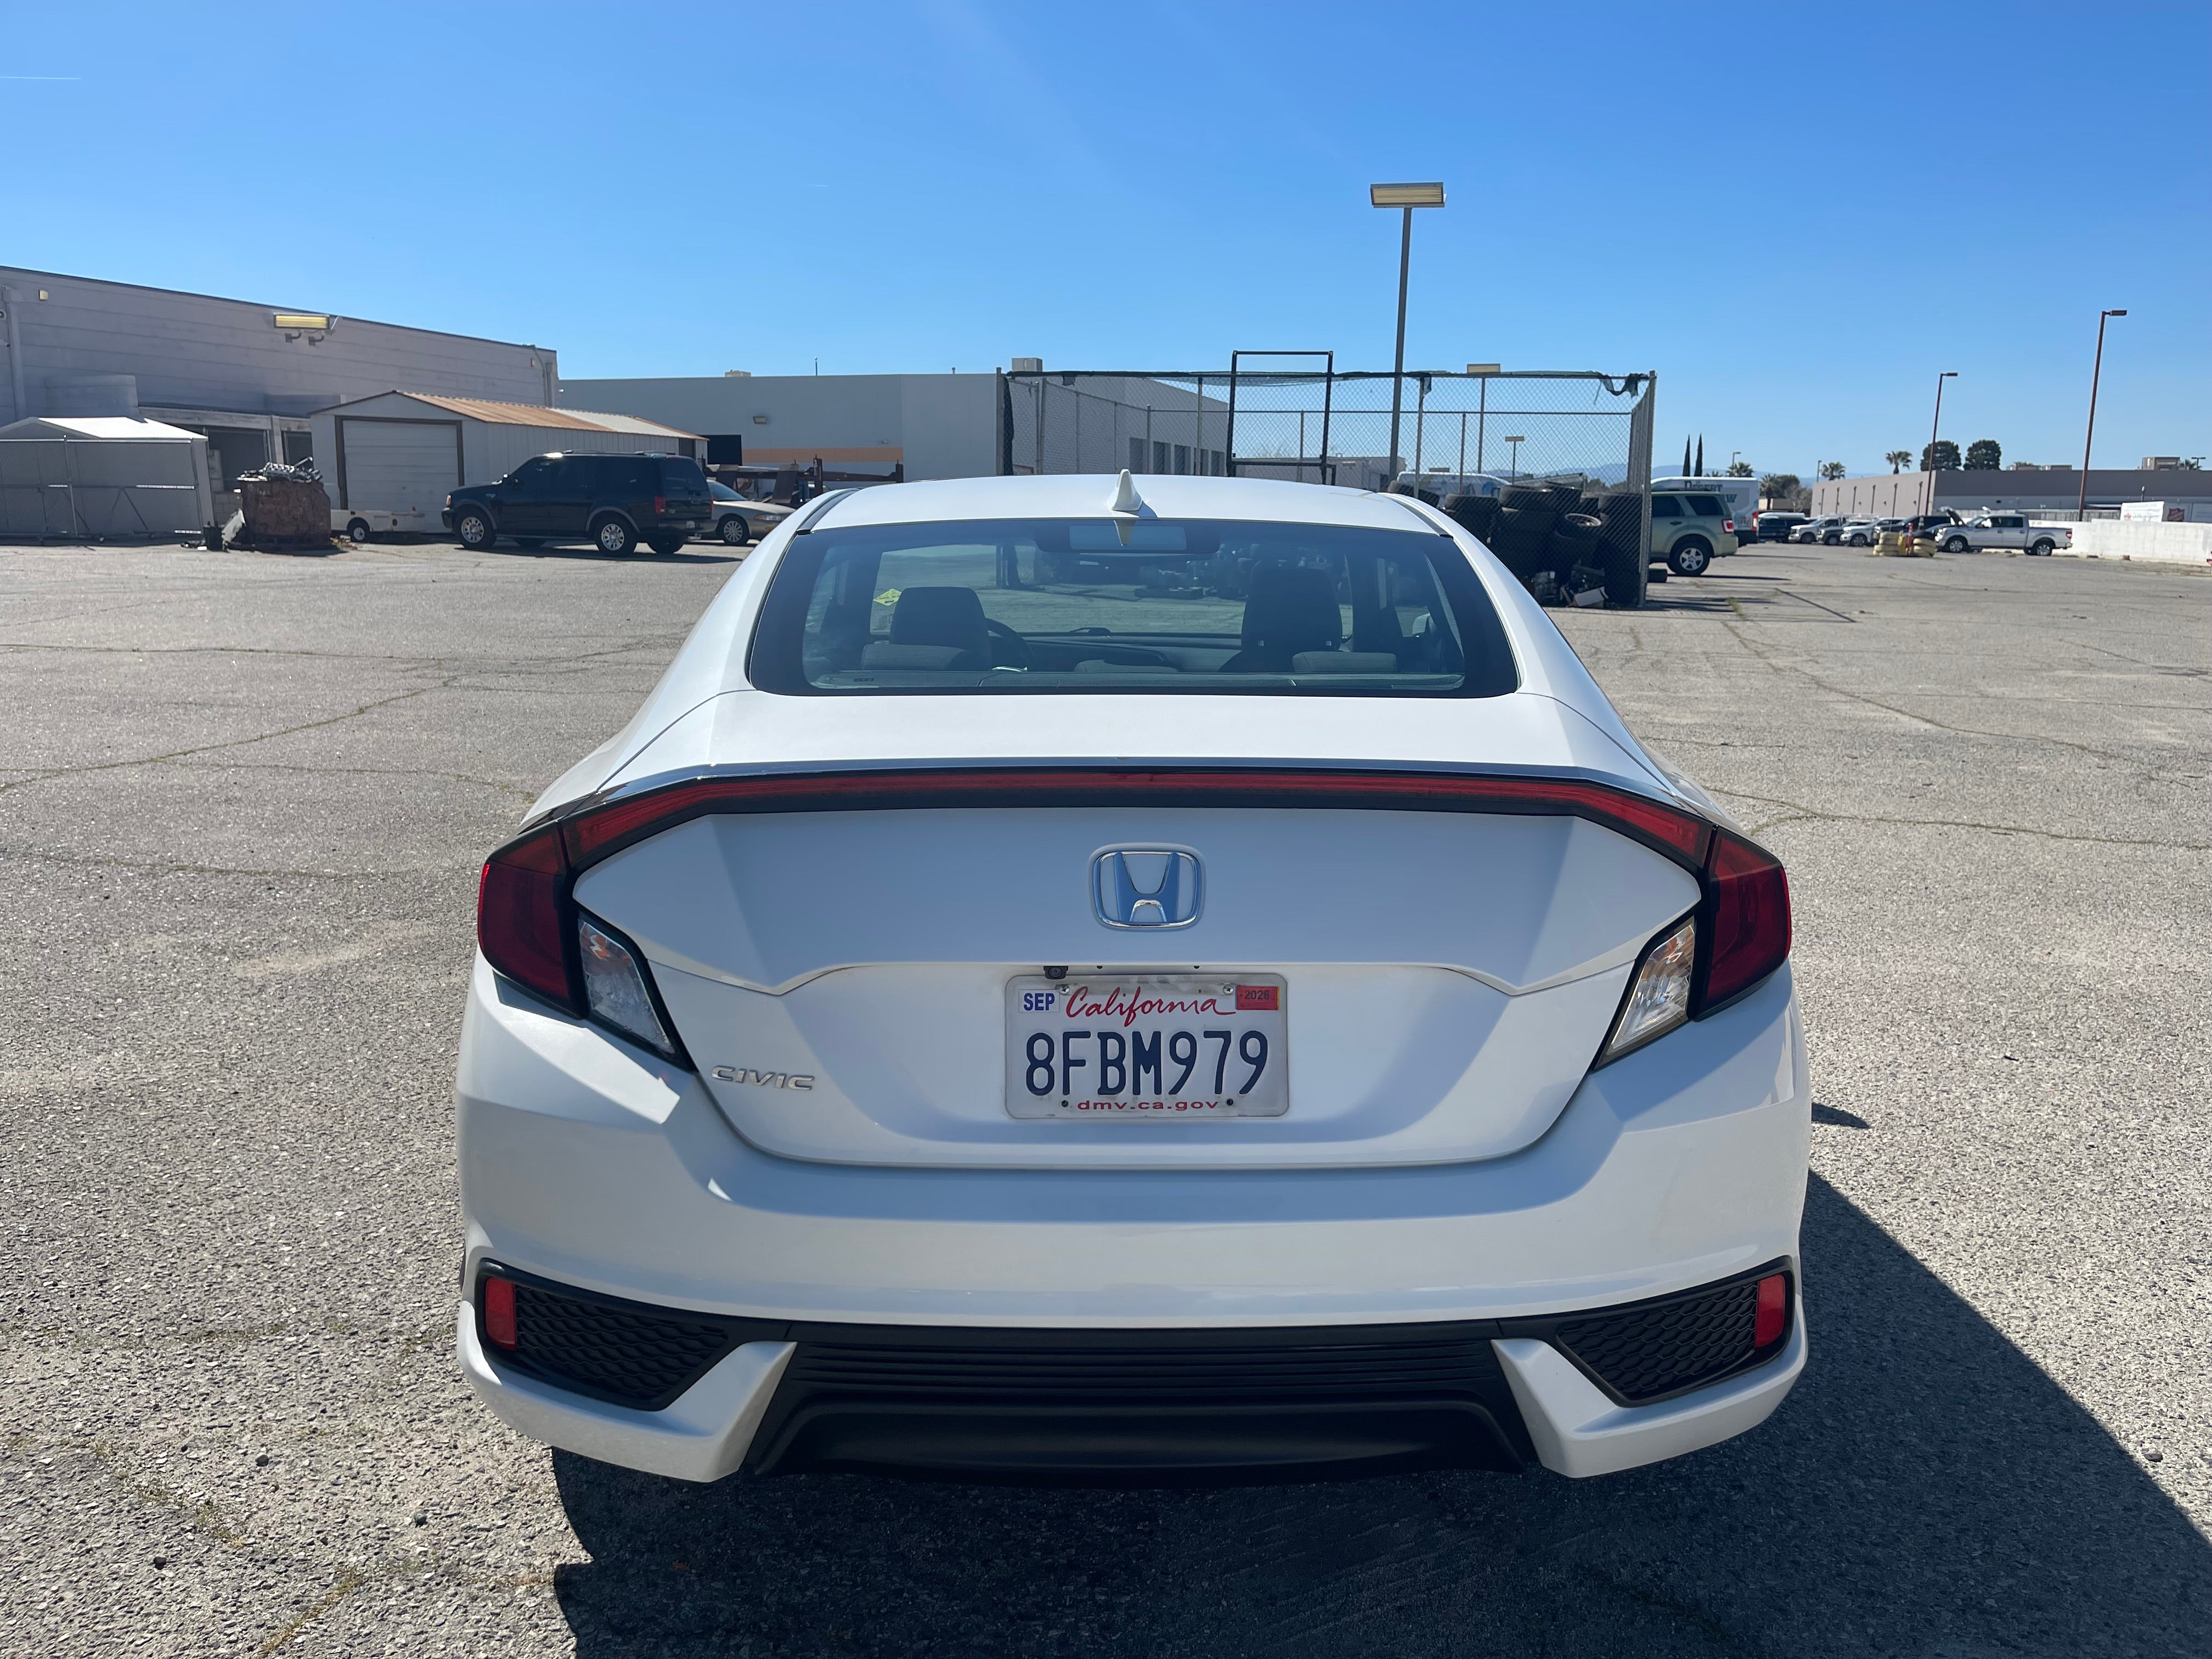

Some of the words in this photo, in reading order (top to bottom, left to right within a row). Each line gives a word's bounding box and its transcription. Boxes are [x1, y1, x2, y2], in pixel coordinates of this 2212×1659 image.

[1023, 992, 1055, 1011] SEP
[1244, 989, 1270, 1000] 2026
[1065, 986, 1237, 1027] California
[1025, 1030, 1268, 1096] 8FBM979
[712, 1065, 815, 1091] CIVIC
[1077, 1100, 1219, 1111] dmv.ca.gov
